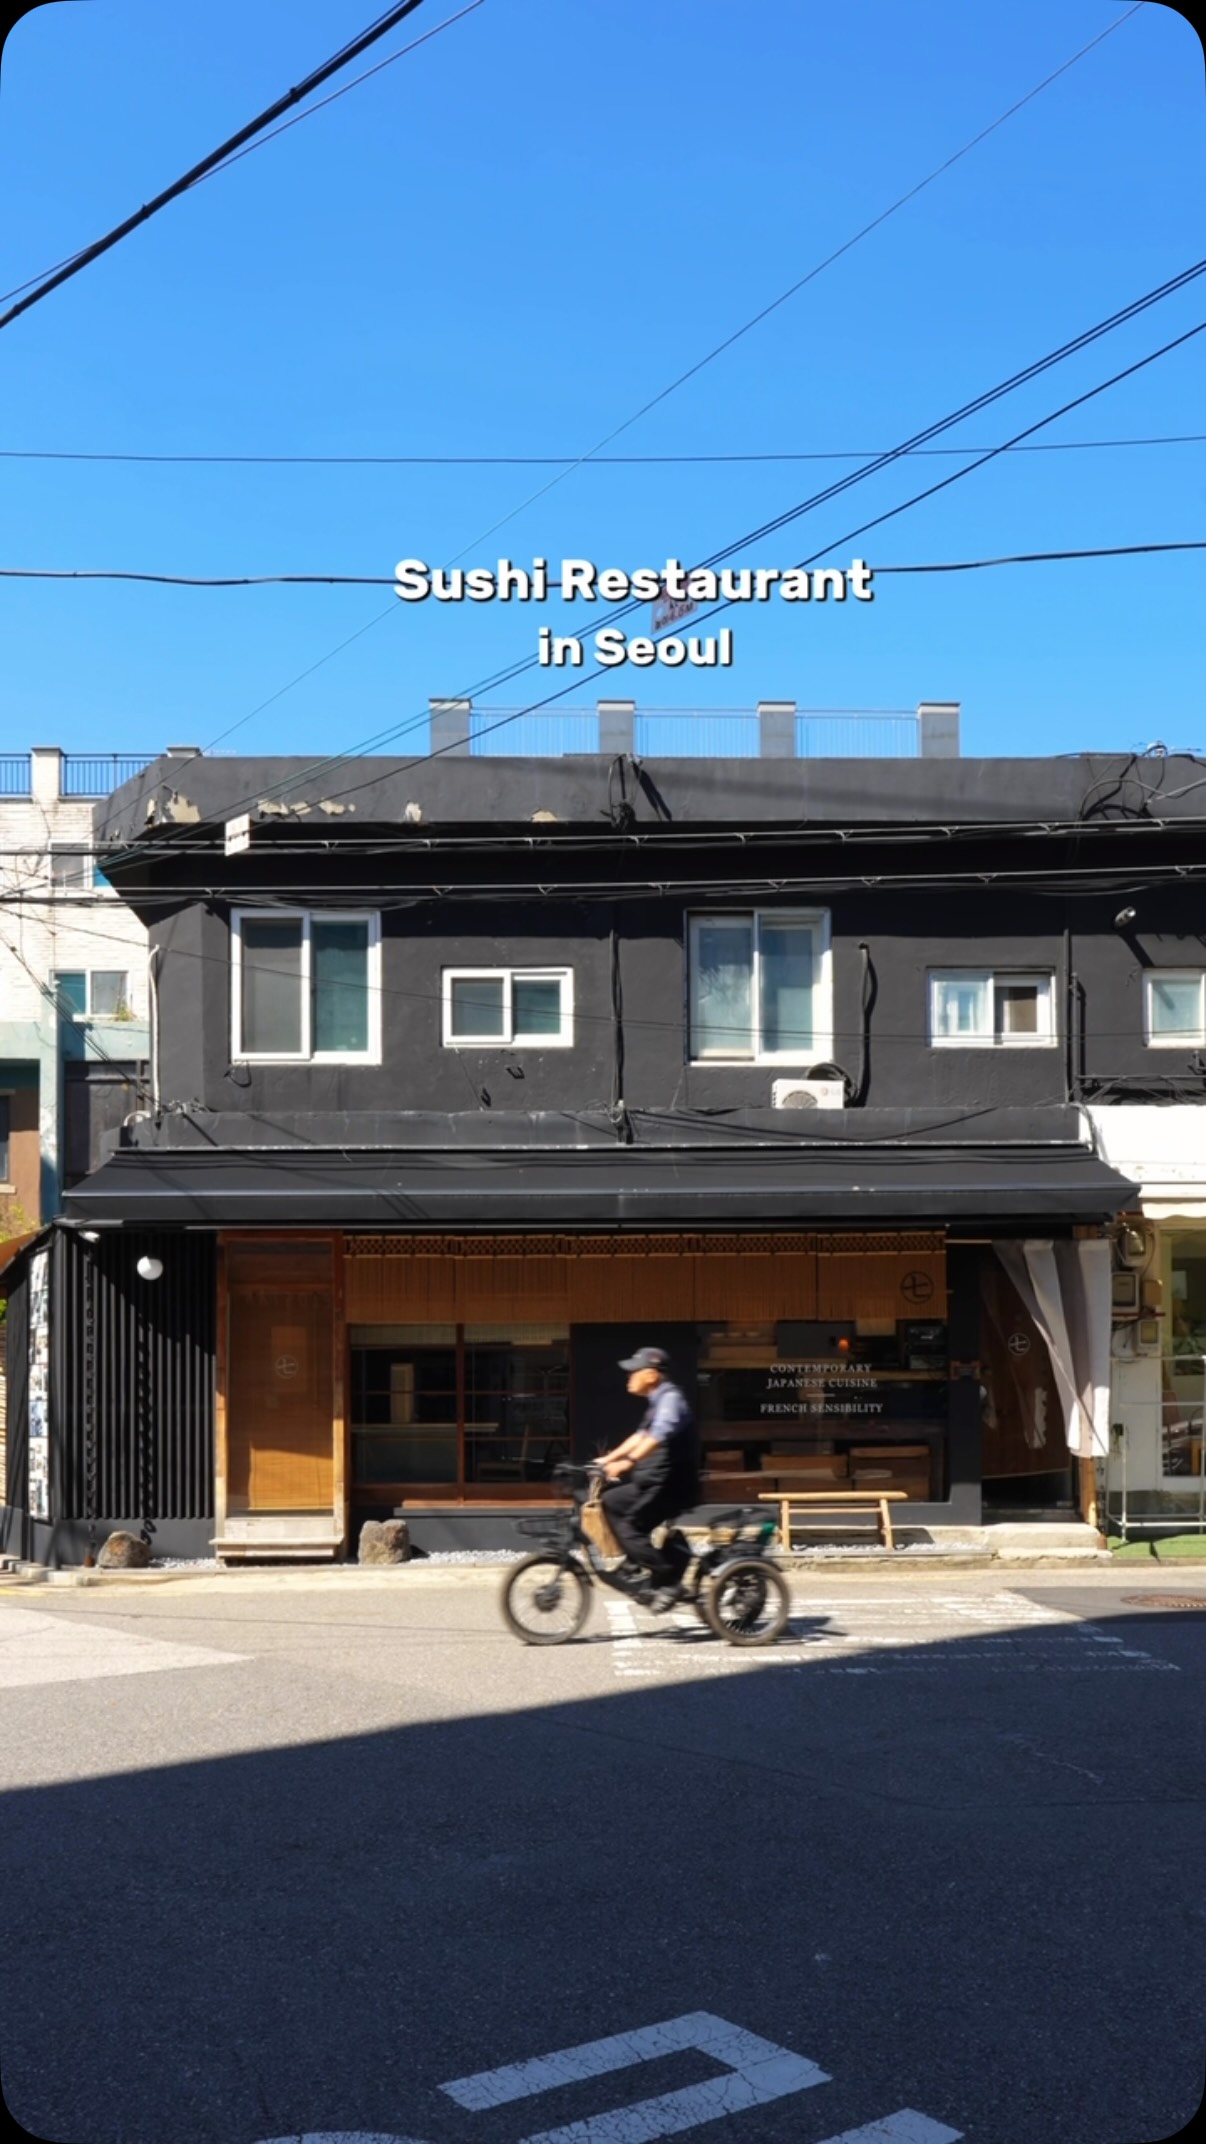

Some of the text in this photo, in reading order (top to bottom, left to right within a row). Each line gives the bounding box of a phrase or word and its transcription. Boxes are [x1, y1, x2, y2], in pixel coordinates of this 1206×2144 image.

[769, 1363, 872, 1374] CONTEMPORARY
[766, 1378, 878, 1389] JAPANESE CUISINE
[760, 1403, 883, 1413] FRENCH SENSIBILITY
